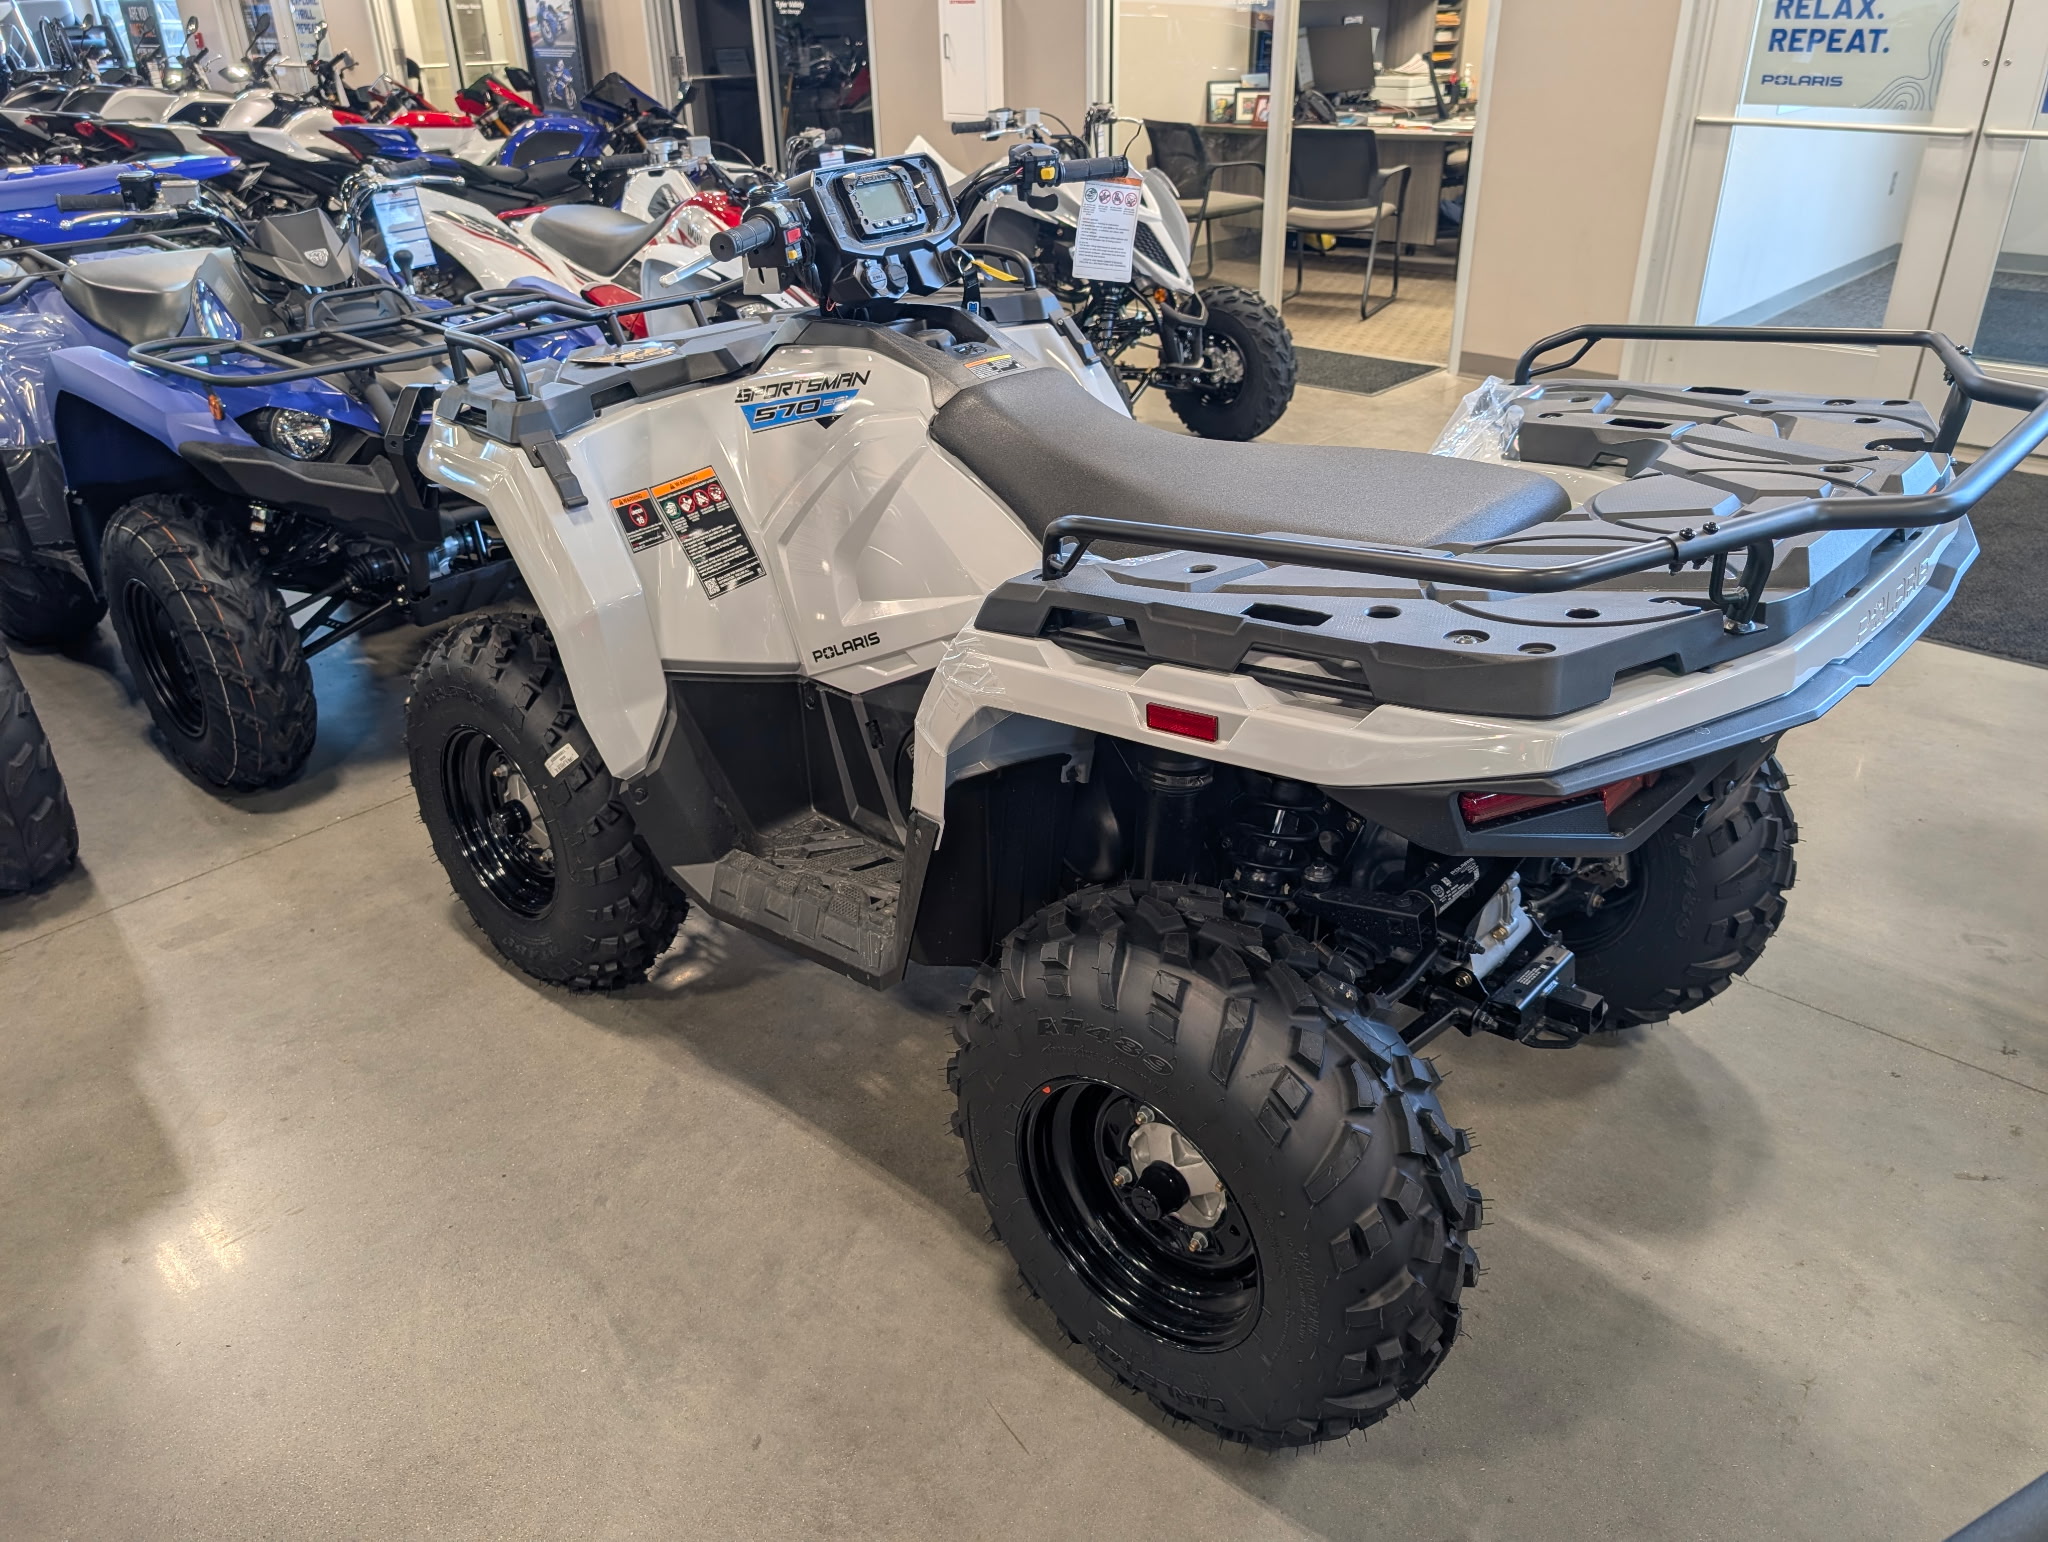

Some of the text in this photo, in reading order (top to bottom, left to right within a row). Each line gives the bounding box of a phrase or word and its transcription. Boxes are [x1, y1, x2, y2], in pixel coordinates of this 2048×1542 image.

[1774, 0, 1884, 20] RELAX.
[1768, 28, 1889, 53] REPEAT.
[1761, 74, 1843, 87] POLARIS
[734, 370, 871, 404] SPORTSMAN
[753, 398, 822, 424] 570
[675, 474, 698, 487] WARNING
[622, 493, 643, 504] WARNING
[812, 631, 881, 663] POLARIS
